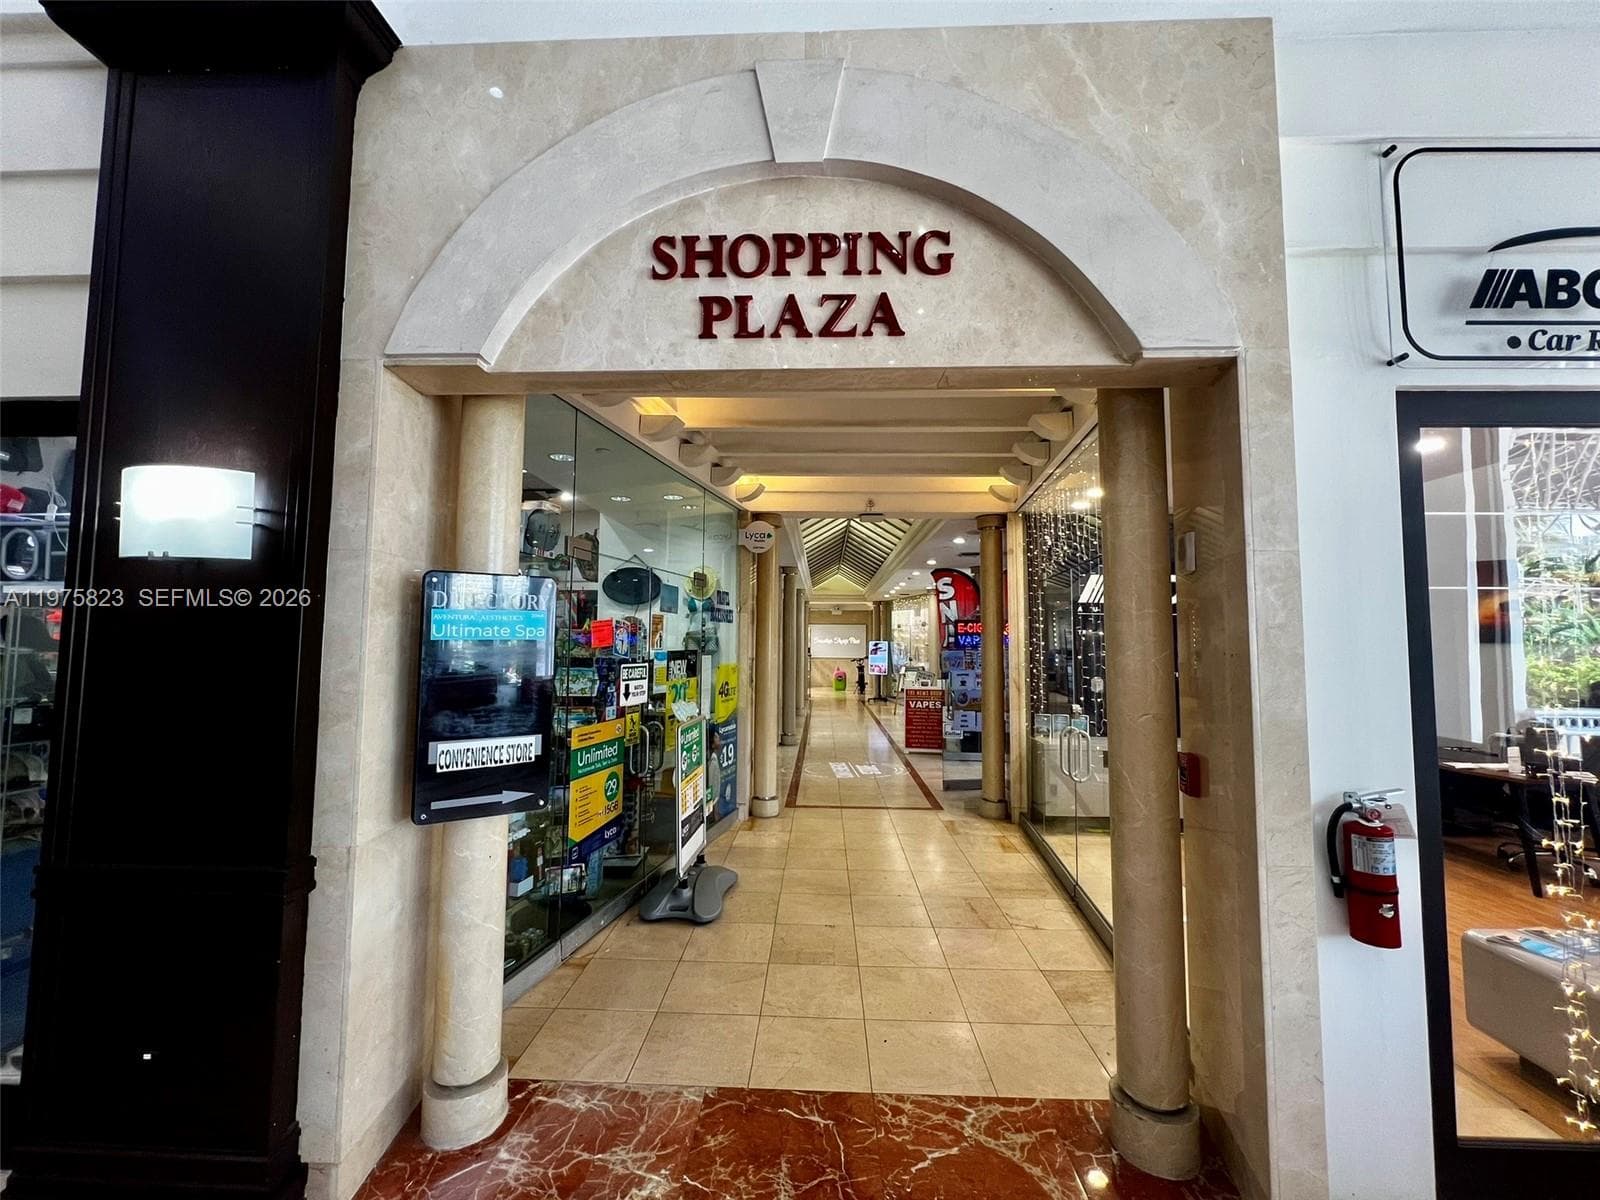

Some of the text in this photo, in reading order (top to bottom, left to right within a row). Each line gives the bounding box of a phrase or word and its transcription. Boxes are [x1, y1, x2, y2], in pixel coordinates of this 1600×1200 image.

[651, 230, 954, 281] SHOPPING
[698, 292, 906, 339] PLAZA
[1528, 329, 1582, 351] Car
[745, 531, 766, 540] Lyca
[432, 623, 545, 639] Ultimate Spa
[957, 622, 983, 633] E-CIG
[958, 635, 981, 645] VAP
[909, 701, 942, 709] VAPES
[438, 742, 533, 770] CONVENIENCE STORE
[577, 741, 618, 767] Unlimited
